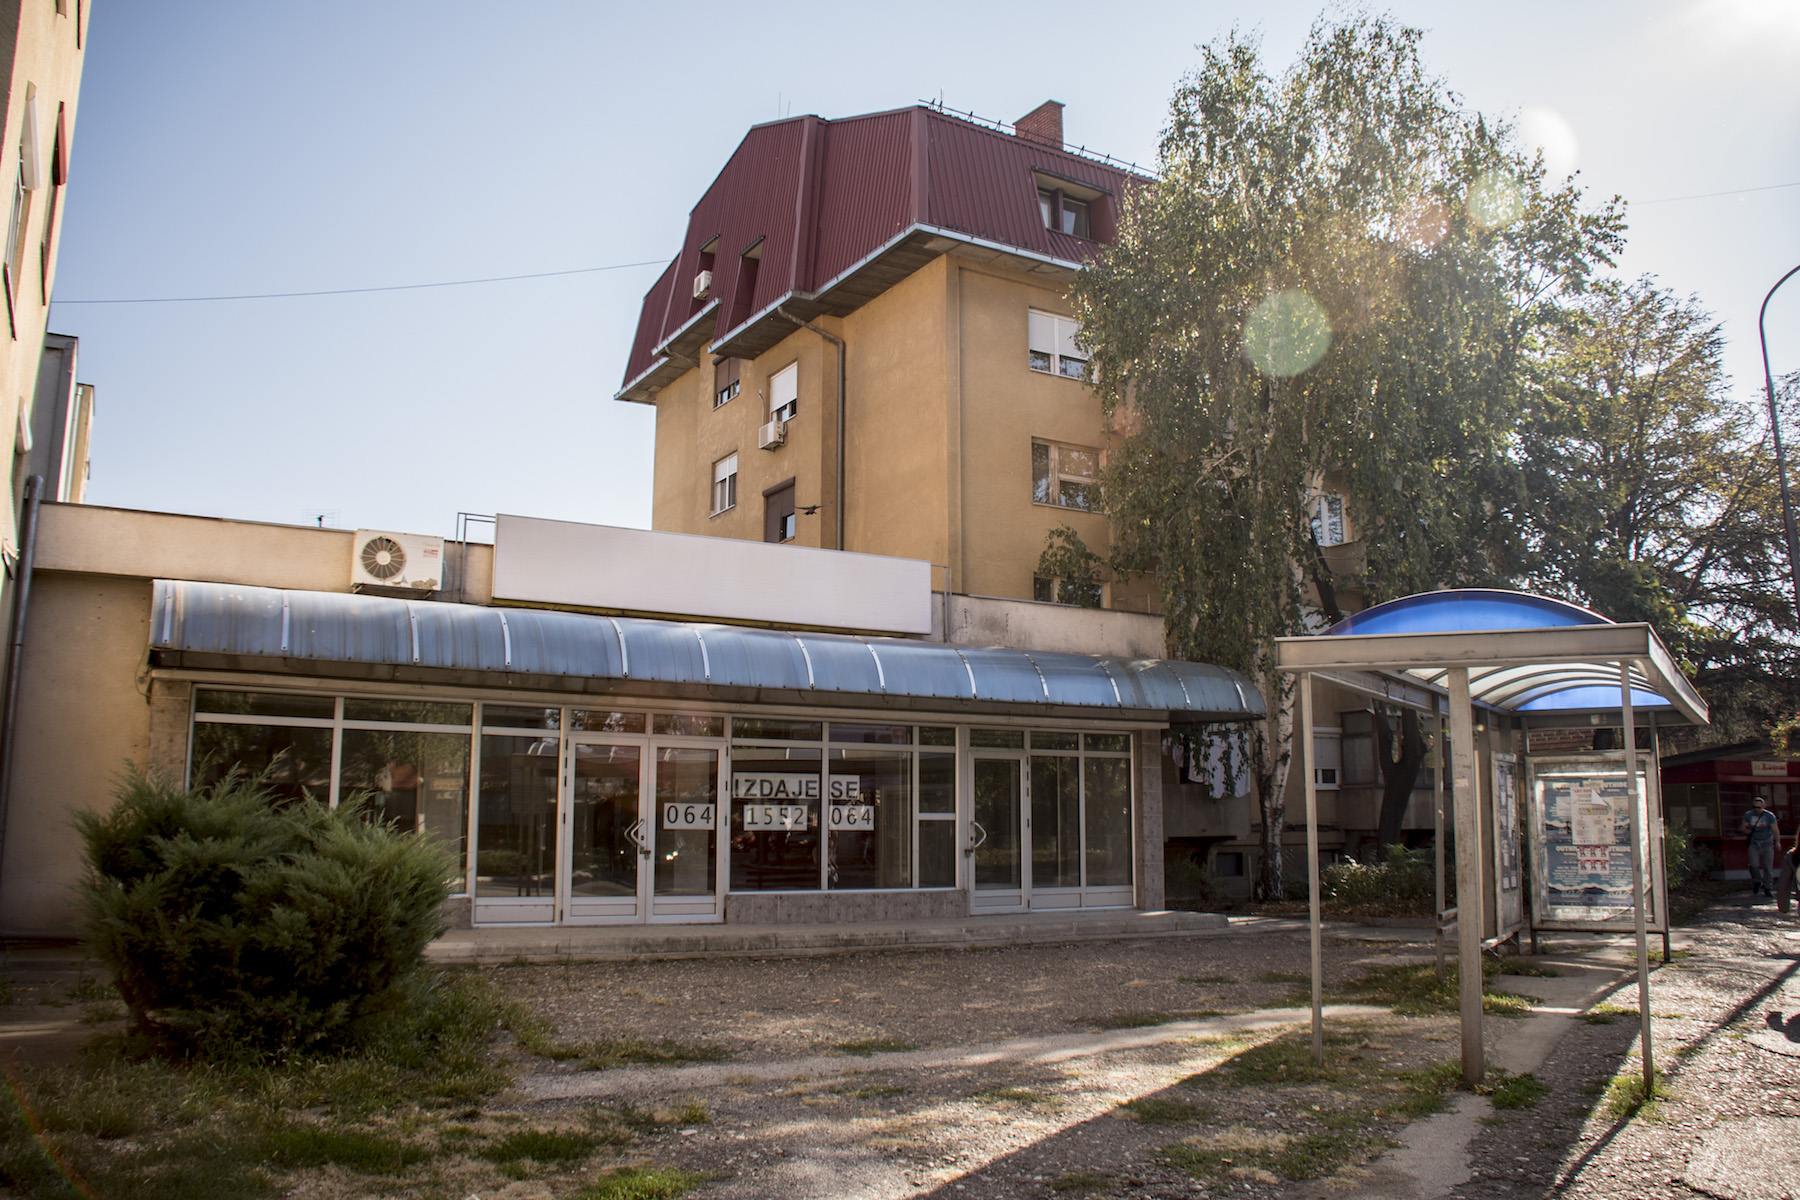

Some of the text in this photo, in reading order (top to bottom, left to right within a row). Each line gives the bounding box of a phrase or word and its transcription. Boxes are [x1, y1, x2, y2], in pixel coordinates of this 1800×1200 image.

[734, 779, 858, 798] IZDAJE SE
[666, 805, 872, 825] 064 1552 064
